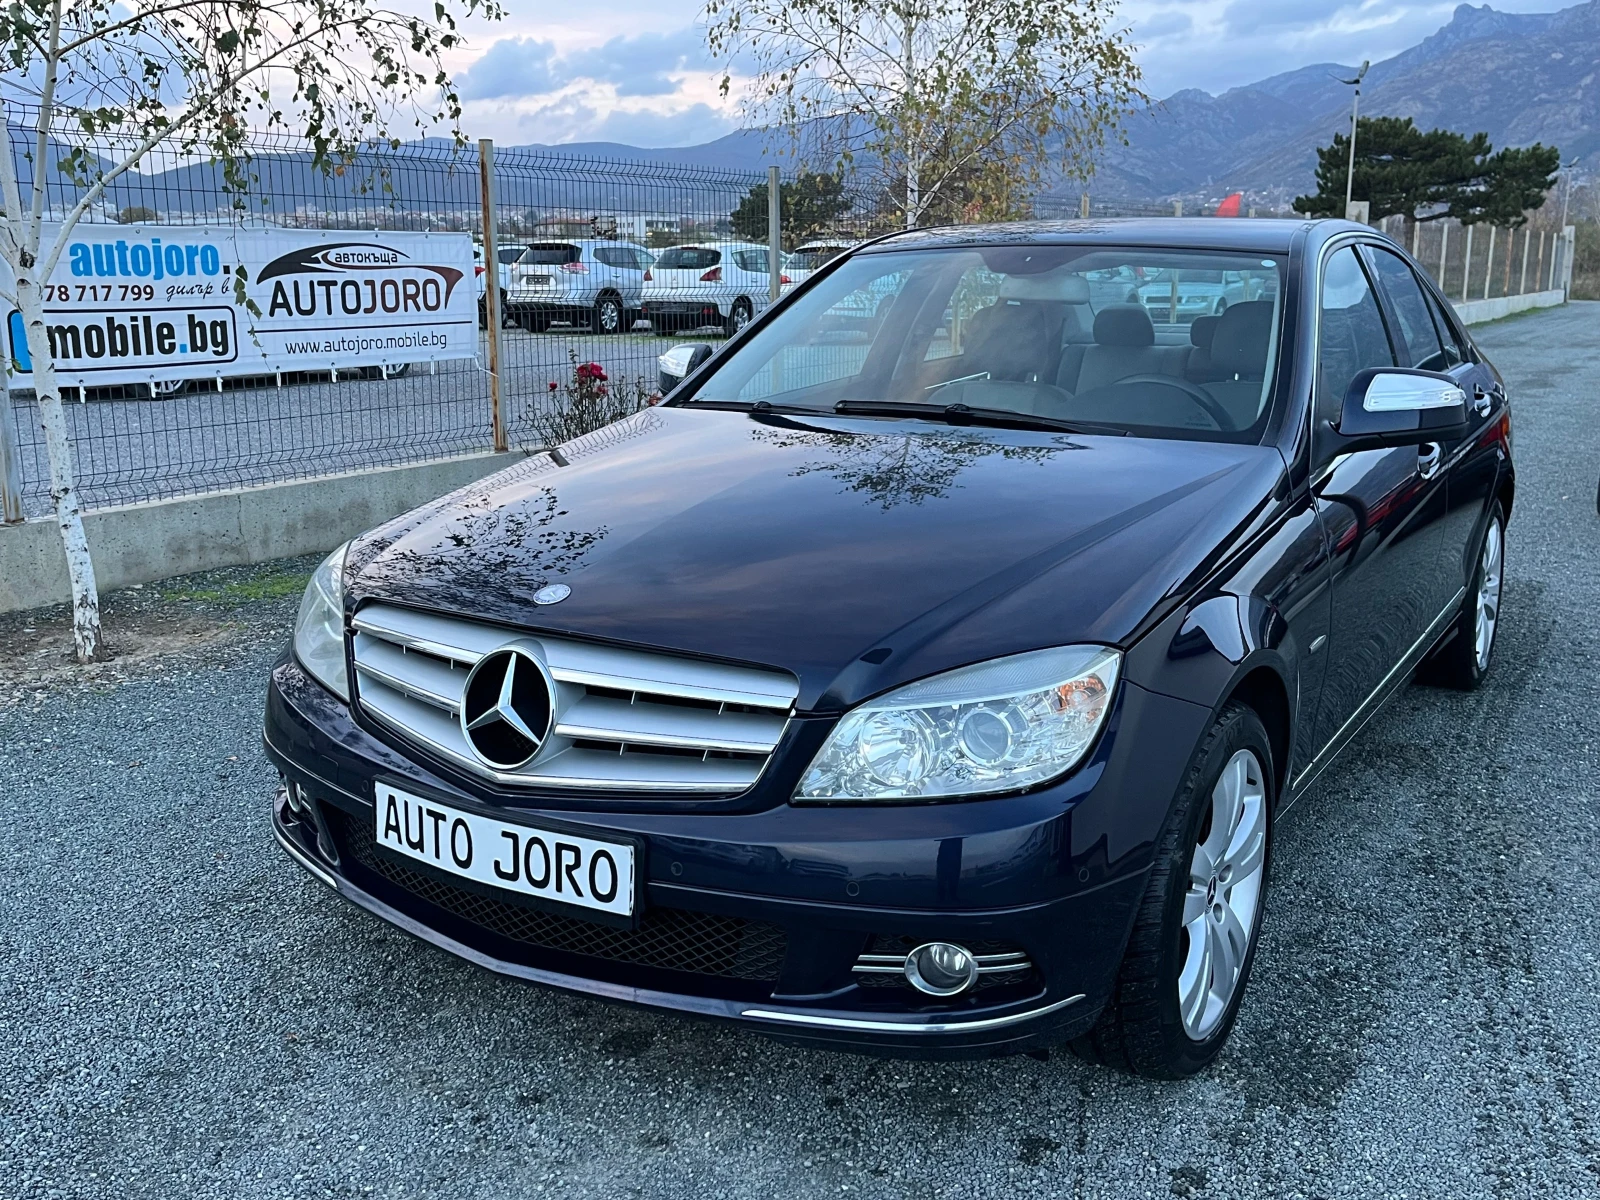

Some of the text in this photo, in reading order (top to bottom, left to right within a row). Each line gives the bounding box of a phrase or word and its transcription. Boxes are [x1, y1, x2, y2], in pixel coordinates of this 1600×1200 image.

[334, 252, 399, 265] автокъща
[75, 284, 112, 302] 717
[118, 284, 154, 302] 799
[166, 281, 214, 302] дилър
[268, 278, 441, 317] AUTOJORO
[46, 313, 229, 359] mobile.bg
[285, 331, 447, 355] www.autojoro.mobile.bg
[384, 794, 618, 903] AUTO JORO
